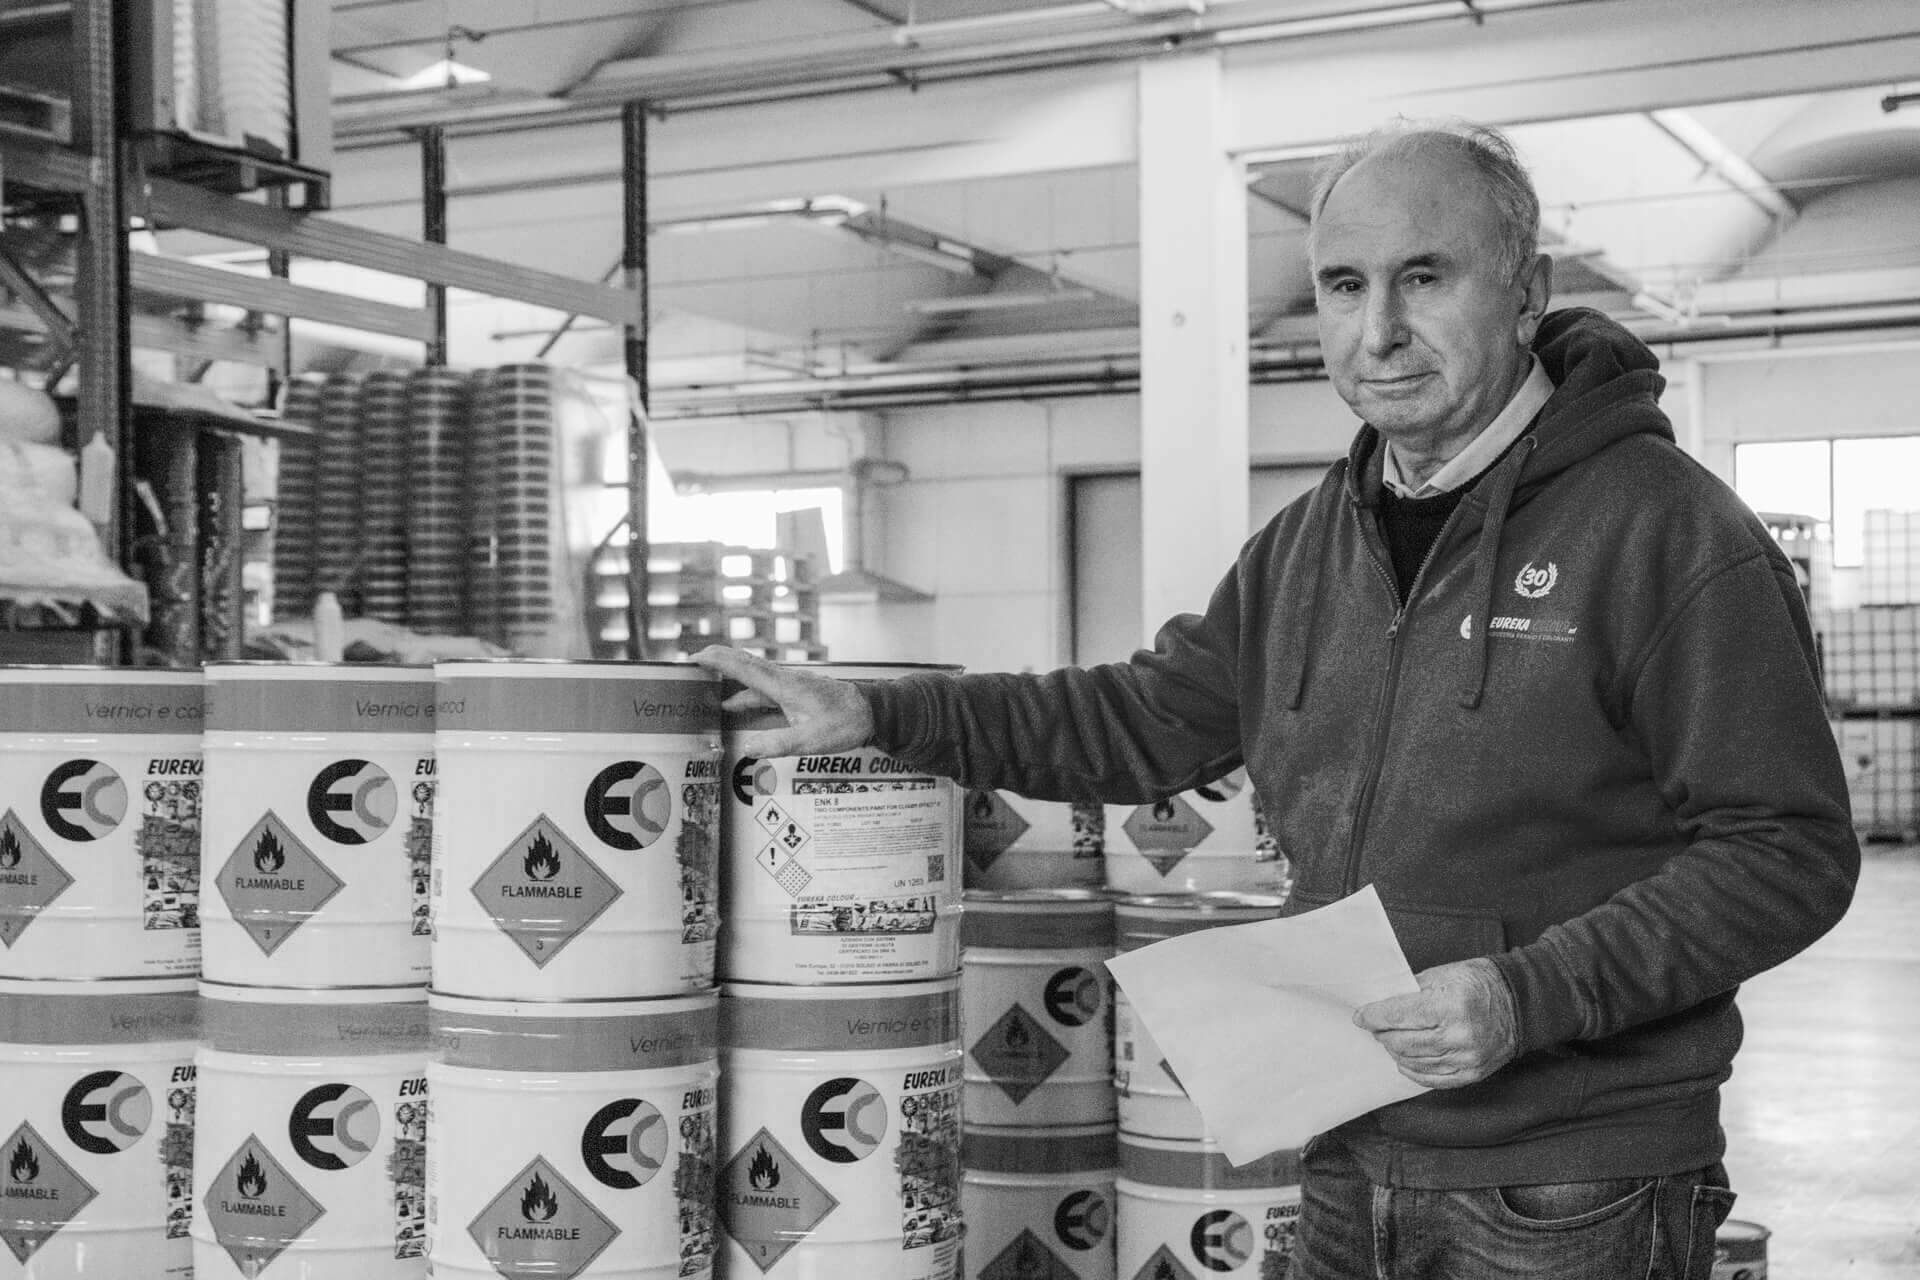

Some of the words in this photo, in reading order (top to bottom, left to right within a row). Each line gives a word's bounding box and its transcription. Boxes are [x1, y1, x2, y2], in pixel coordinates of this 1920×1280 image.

[1523, 568, 1548, 587] 30
[1489, 616, 1531, 631] EUREKA
[85, 702, 152, 720] Vernici
[157, 705, 170, 719] e
[175, 705, 204, 720] co
[356, 700, 419, 718] Vernici
[796, 757, 862, 774] EUREKA
[814, 798, 832, 807] ENK
[235, 878, 305, 891] FLAMMABLE
[894, 879, 906, 888] UN
[501, 884, 583, 899] FLAMMABLE
[536, 939, 545, 951] 3
[848, 1018, 907, 1035] Vernici
[903, 1067, 946, 1090] EUREKA
[221, 1201, 287, 1217] FLAMMABLE
[498, 1226, 581, 1240] FLAMMABLE
[760, 1245, 767, 1257] 3
